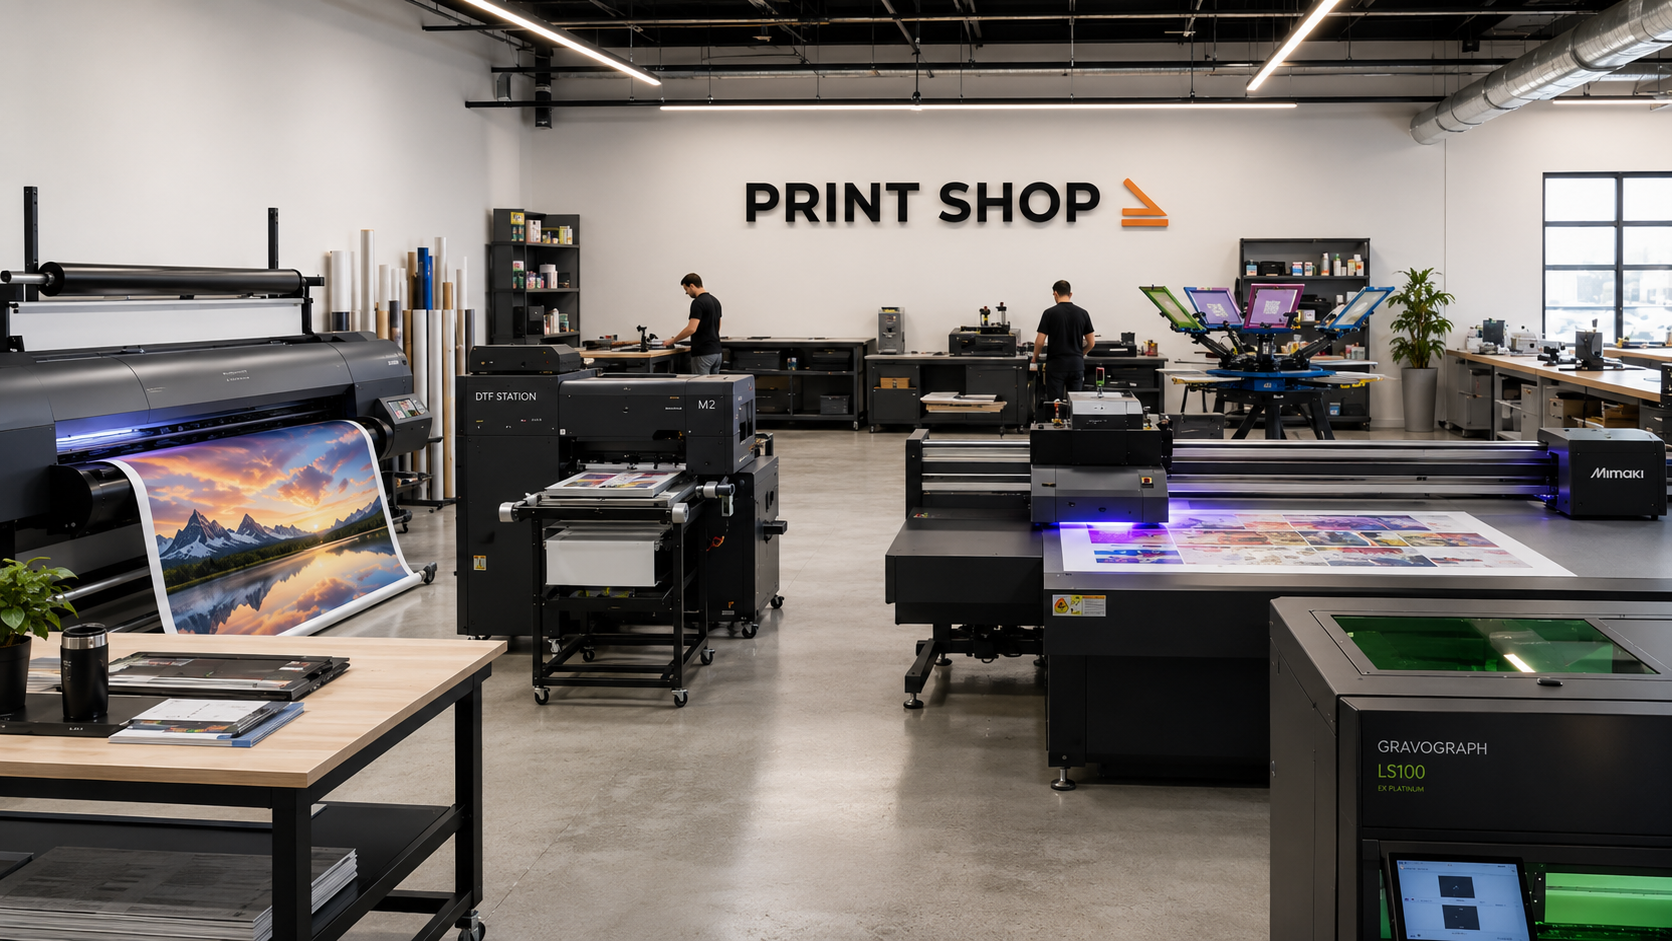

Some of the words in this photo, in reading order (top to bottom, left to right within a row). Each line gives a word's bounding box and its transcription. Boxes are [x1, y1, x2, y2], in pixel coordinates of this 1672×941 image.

[745, 182, 920, 223] PRINT
[938, 181, 1101, 223] SHOP
[475, 392, 494, 401] DTF
[496, 392, 537, 401] STATION
[698, 399, 716, 410] M2
[1590, 467, 1644, 479] Mimaki
[1377, 739, 1488, 755] GRAVOGRAPH
[1378, 763, 1426, 780] LS100
[1378, 784, 1387, 792] EX
[1388, 785, 1425, 793] PLATINUM
